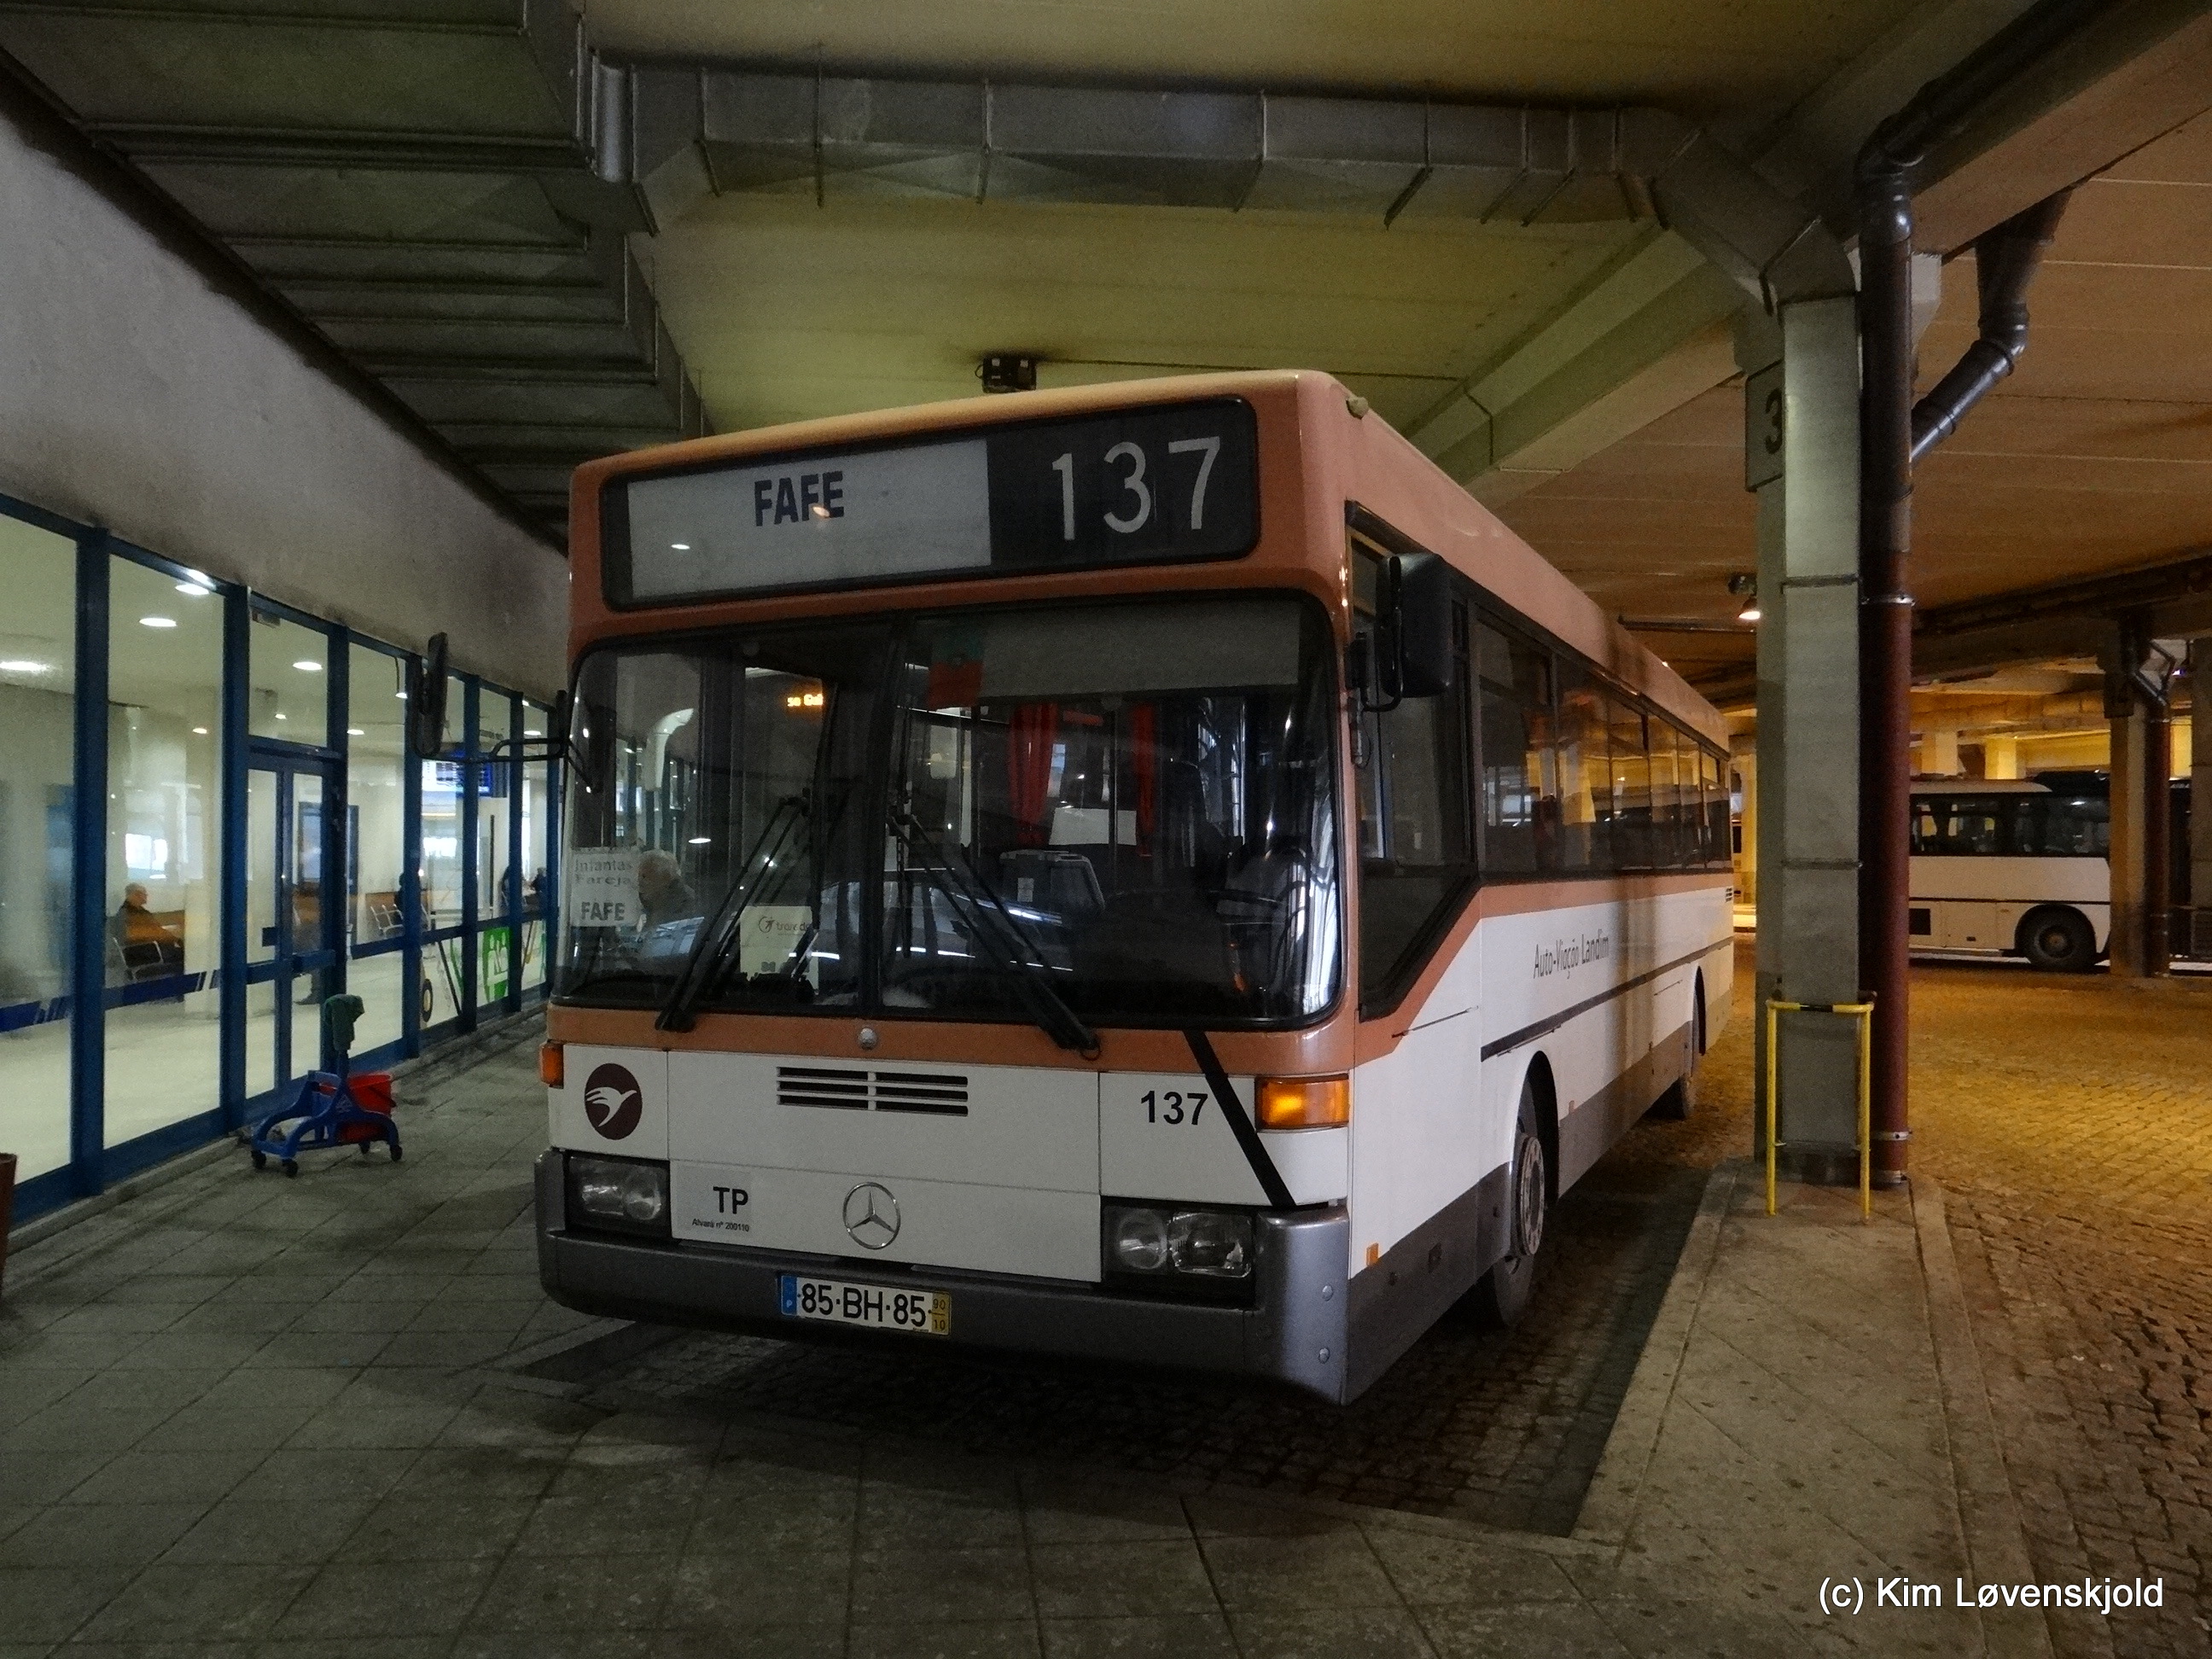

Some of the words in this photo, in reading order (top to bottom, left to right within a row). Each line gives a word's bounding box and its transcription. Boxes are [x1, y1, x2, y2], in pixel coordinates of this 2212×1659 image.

[1764, 388, 1783, 454] 3
[754, 470, 844, 527] FAFE
[1051, 436, 1221, 541] 137
[581, 901, 626, 922] FAFE
[1533, 938, 1580, 980] Auto-Viação
[1581, 928, 1610, 964] Landim
[1140, 1090, 1208, 1126] 137
[713, 1186, 748, 1214] TP
[725, 1221, 750, 1231] 200110
[934, 1319, 946, 1331] 10
